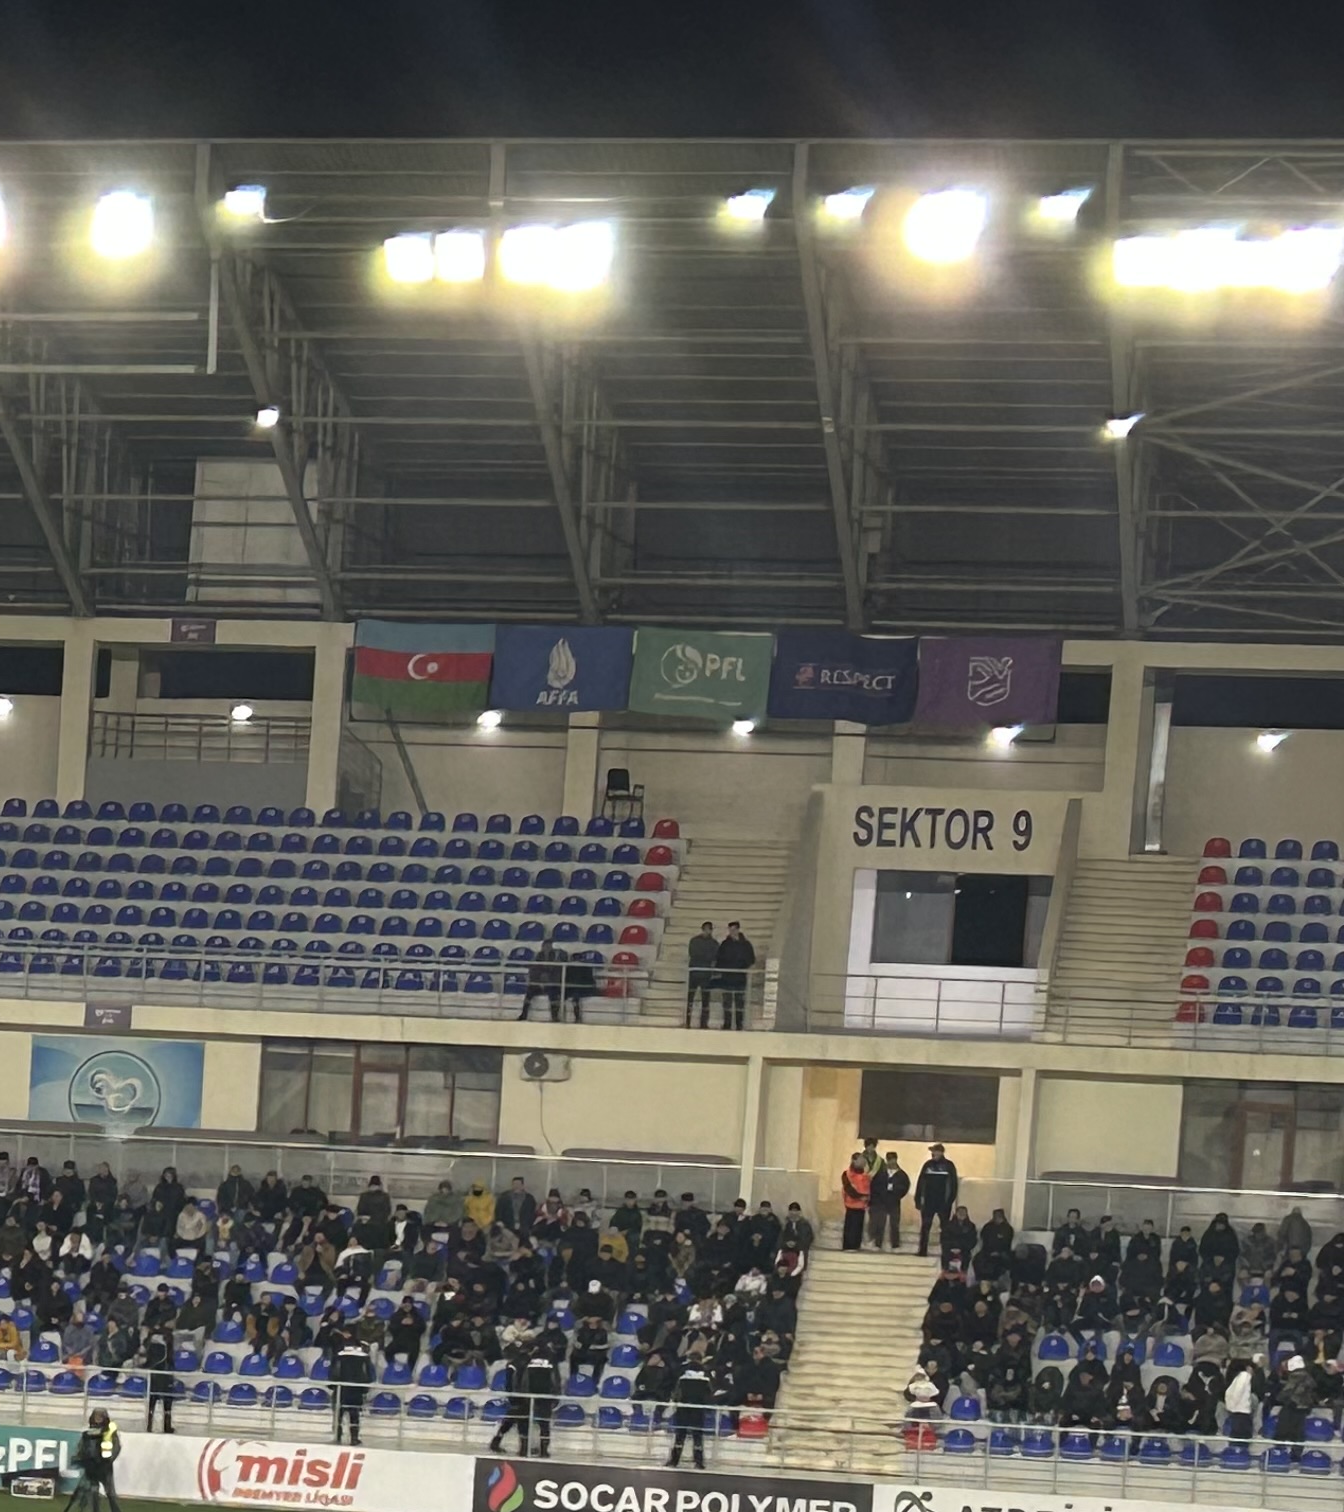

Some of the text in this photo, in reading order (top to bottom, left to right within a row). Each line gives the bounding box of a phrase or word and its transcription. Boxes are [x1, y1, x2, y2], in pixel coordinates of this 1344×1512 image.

[705, 654, 746, 682] PFL
[853, 805, 1033, 851] SEKTOR 9
[236, 1449, 366, 1490] misli
